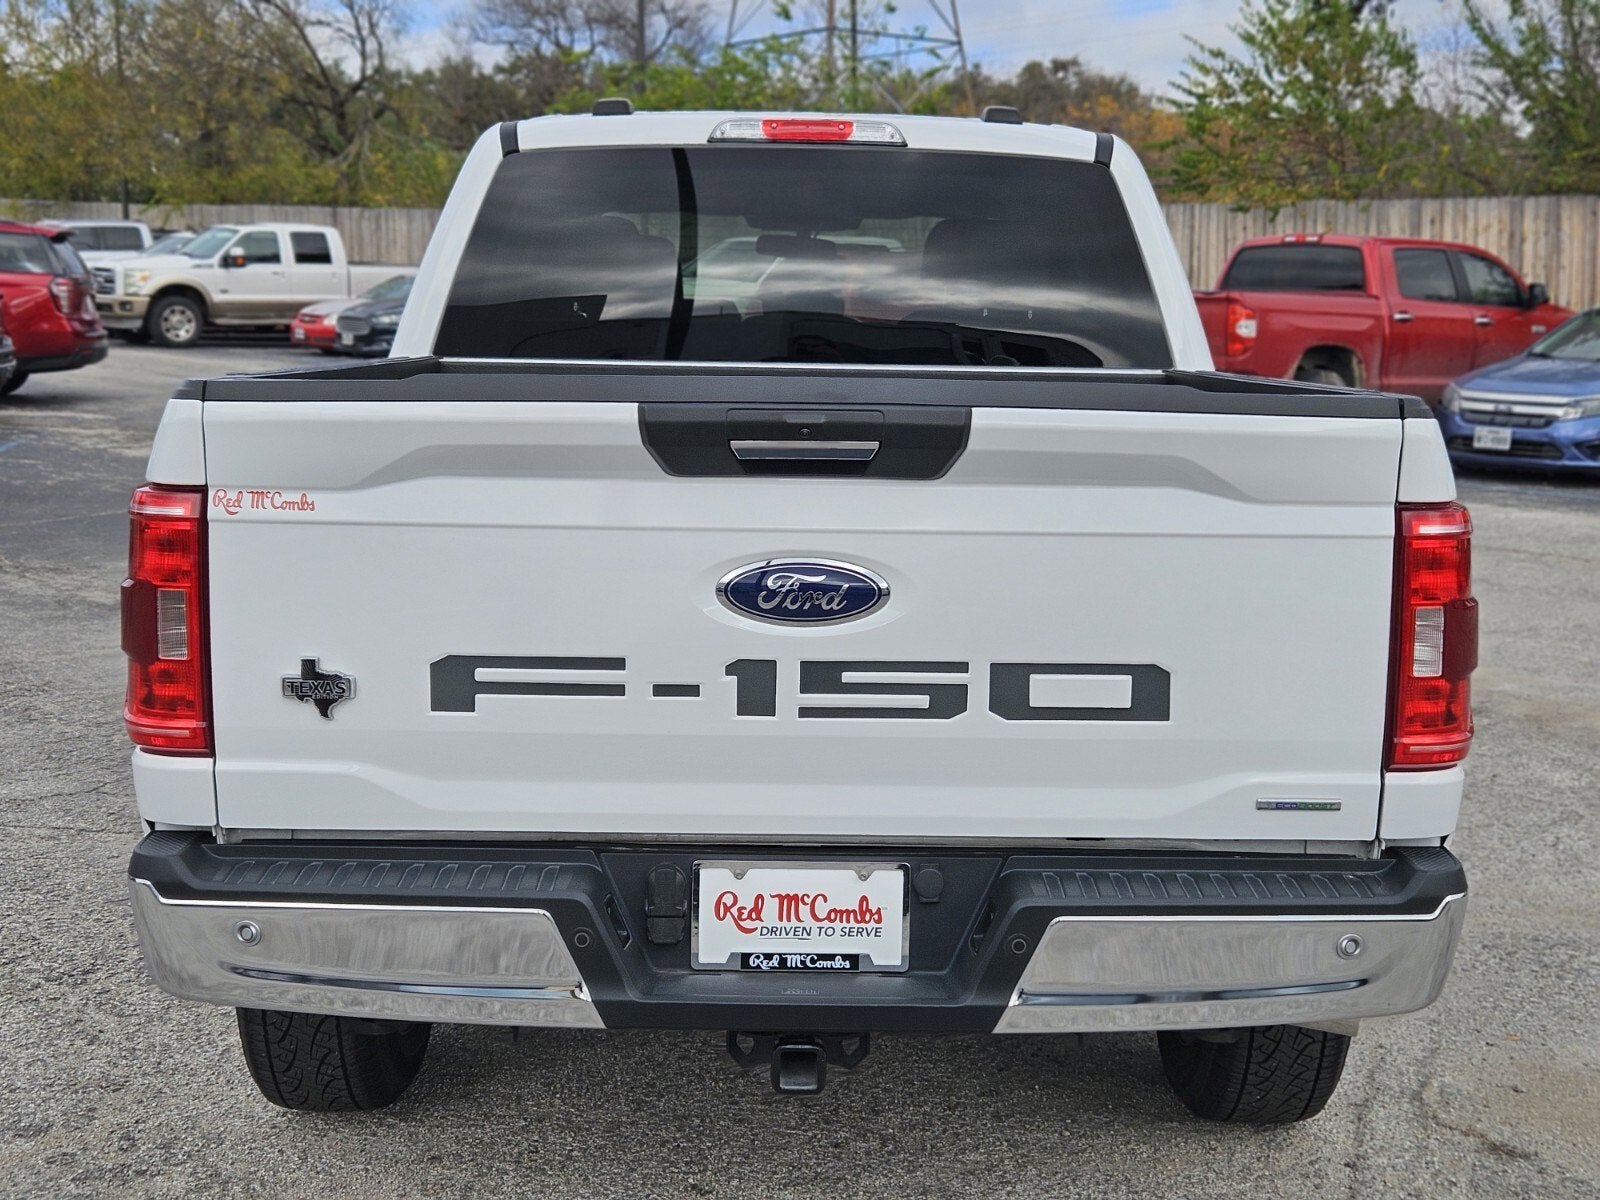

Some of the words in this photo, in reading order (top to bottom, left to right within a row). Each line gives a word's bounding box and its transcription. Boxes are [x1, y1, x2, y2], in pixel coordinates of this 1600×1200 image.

[213, 489, 243, 515] Red
[246, 490, 315, 512] McCombs
[757, 572, 850, 611] Ford
[286, 681, 346, 694] TEXAS
[430, 654, 1171, 722] F-150
[714, 890, 765, 934] Red
[769, 893, 883, 925] McCombs
[759, 926, 812, 937] DRIVEN
[817, 926, 836, 938] TO
[840, 927, 883, 938] SERVE
[749, 953, 780, 970] Red
[782, 953, 851, 969] McCombs
